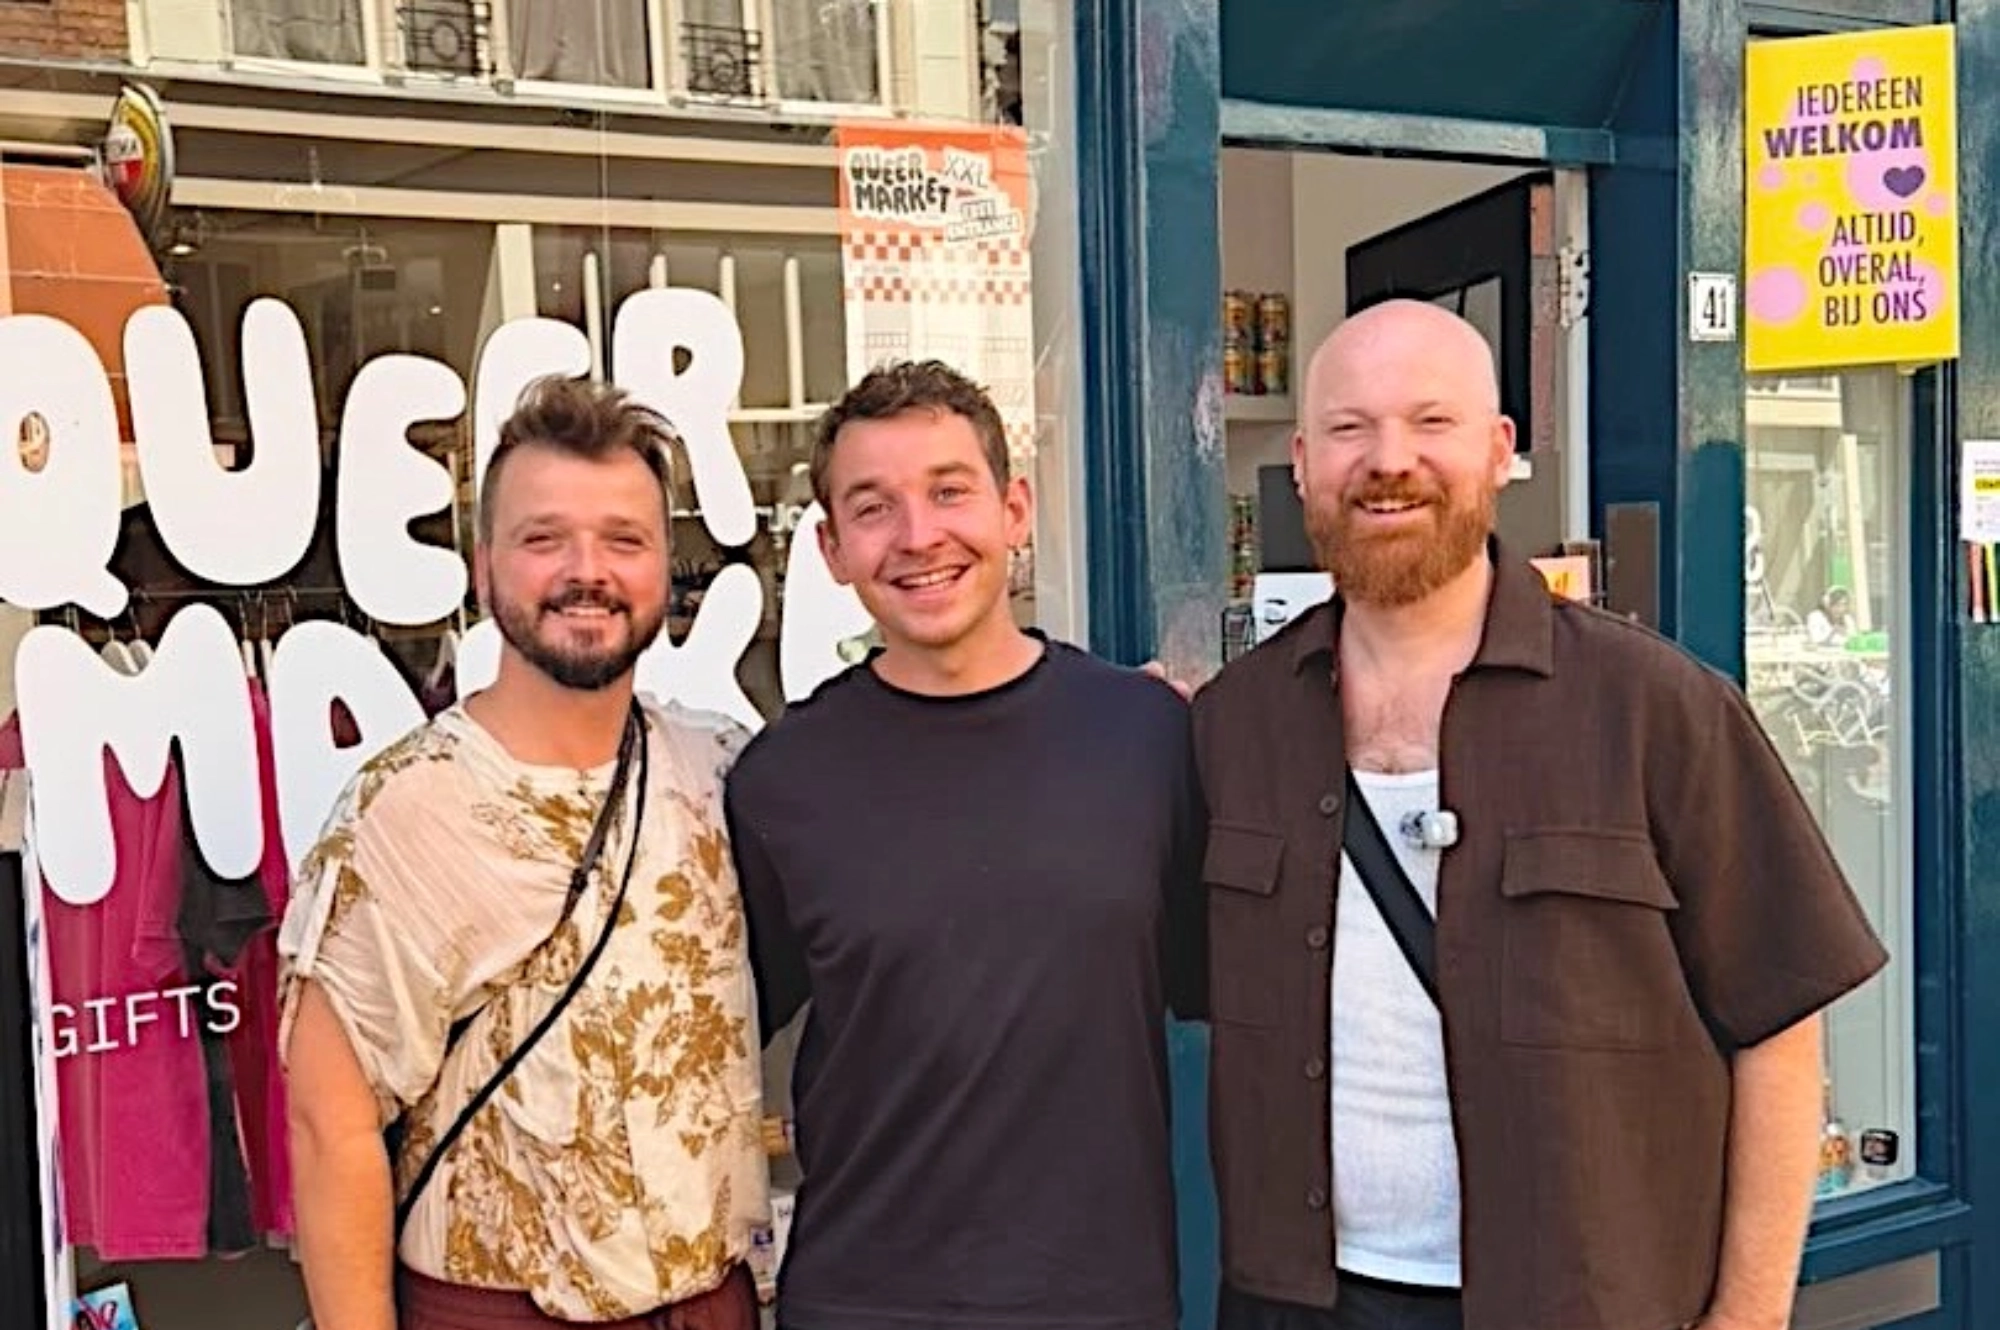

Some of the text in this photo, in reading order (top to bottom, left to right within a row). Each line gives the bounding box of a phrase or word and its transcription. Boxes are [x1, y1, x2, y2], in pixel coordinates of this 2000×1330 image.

[1797, 76, 1923, 117] IEDEREEN
[1764, 118, 1923, 158] WELKOM
[851, 153, 923, 185] QUEER
[946, 155, 988, 188] XXL
[856, 177, 951, 213] MARKET
[1832, 211, 1925, 247] ALTIJD,
[1819, 251, 1926, 287] OVERAL,
[1703, 286, 1727, 330] 41
[1825, 290, 1927, 326] BIJ ONS
[50, 981, 240, 1058] GIFTS
